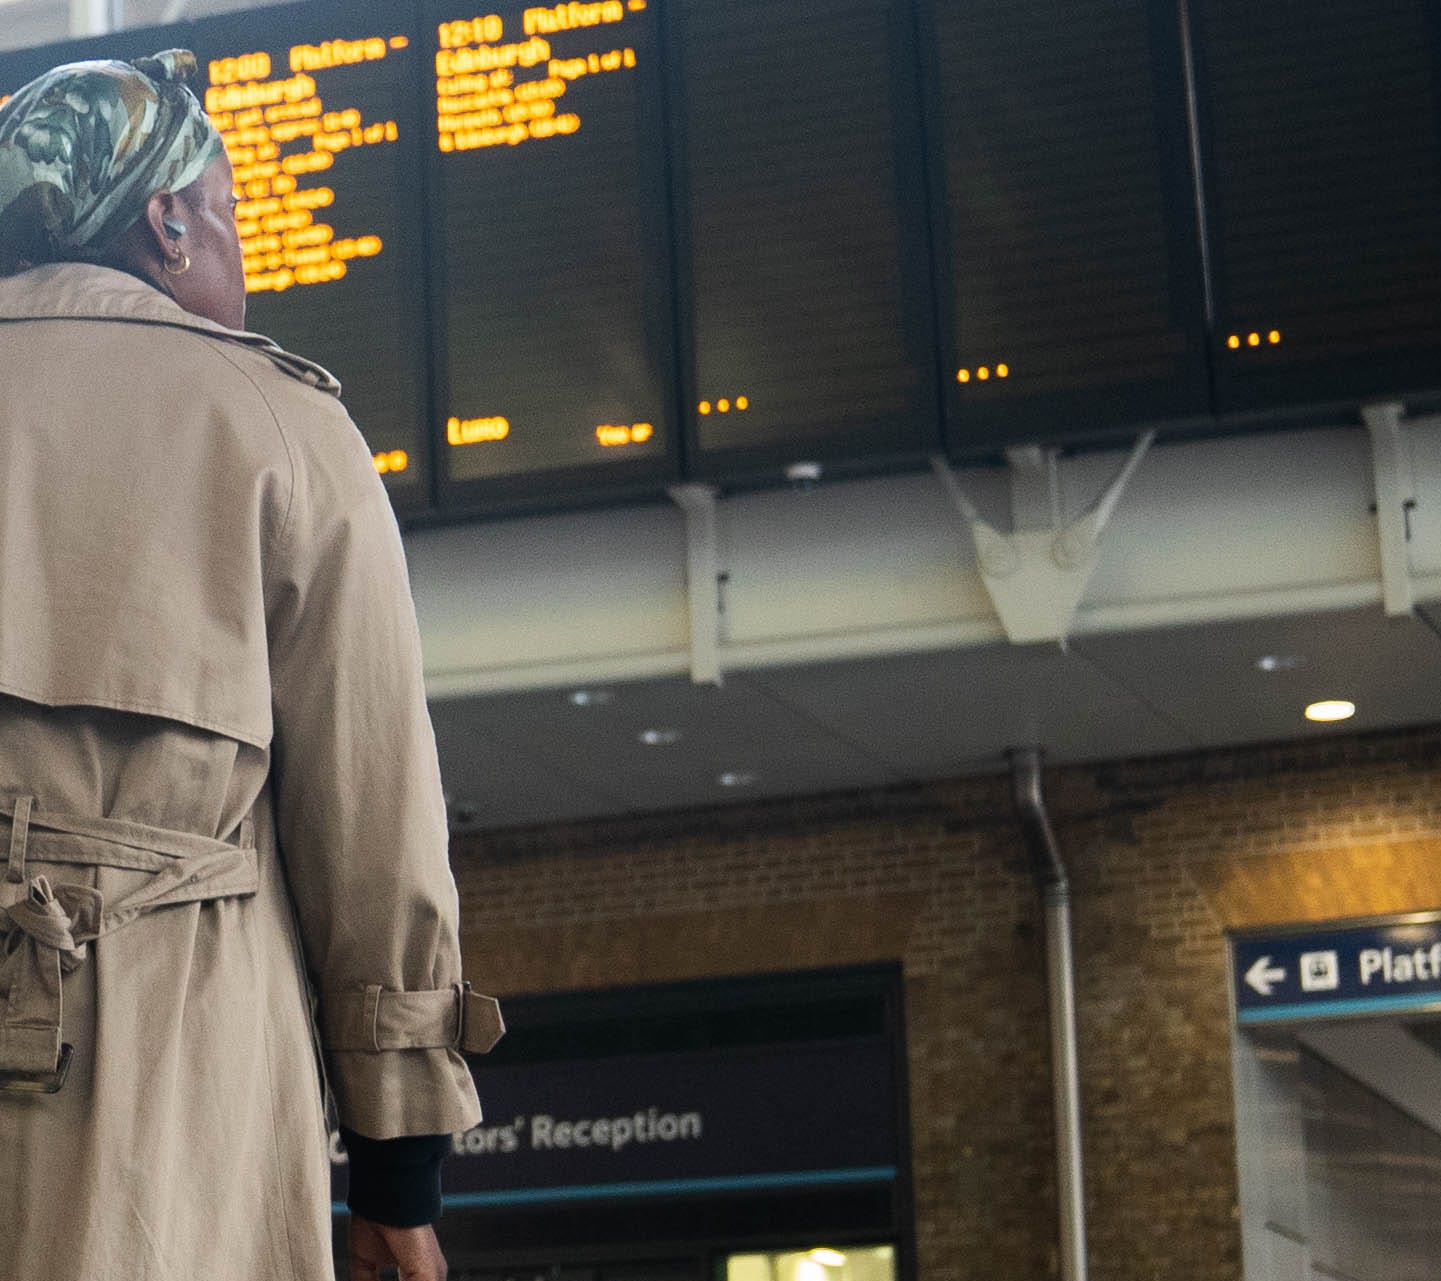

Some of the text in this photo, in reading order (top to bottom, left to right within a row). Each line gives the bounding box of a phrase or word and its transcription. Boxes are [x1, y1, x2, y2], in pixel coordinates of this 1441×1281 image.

[524, 0, 623, 35] Platform
[290, 37, 386, 71] Platform
[436, 36, 550, 76] Edinburgh
[205, 73, 316, 113] Edinburgh
[448, 416, 509, 445] Lumo
[531, 1108, 704, 1154] Reception
